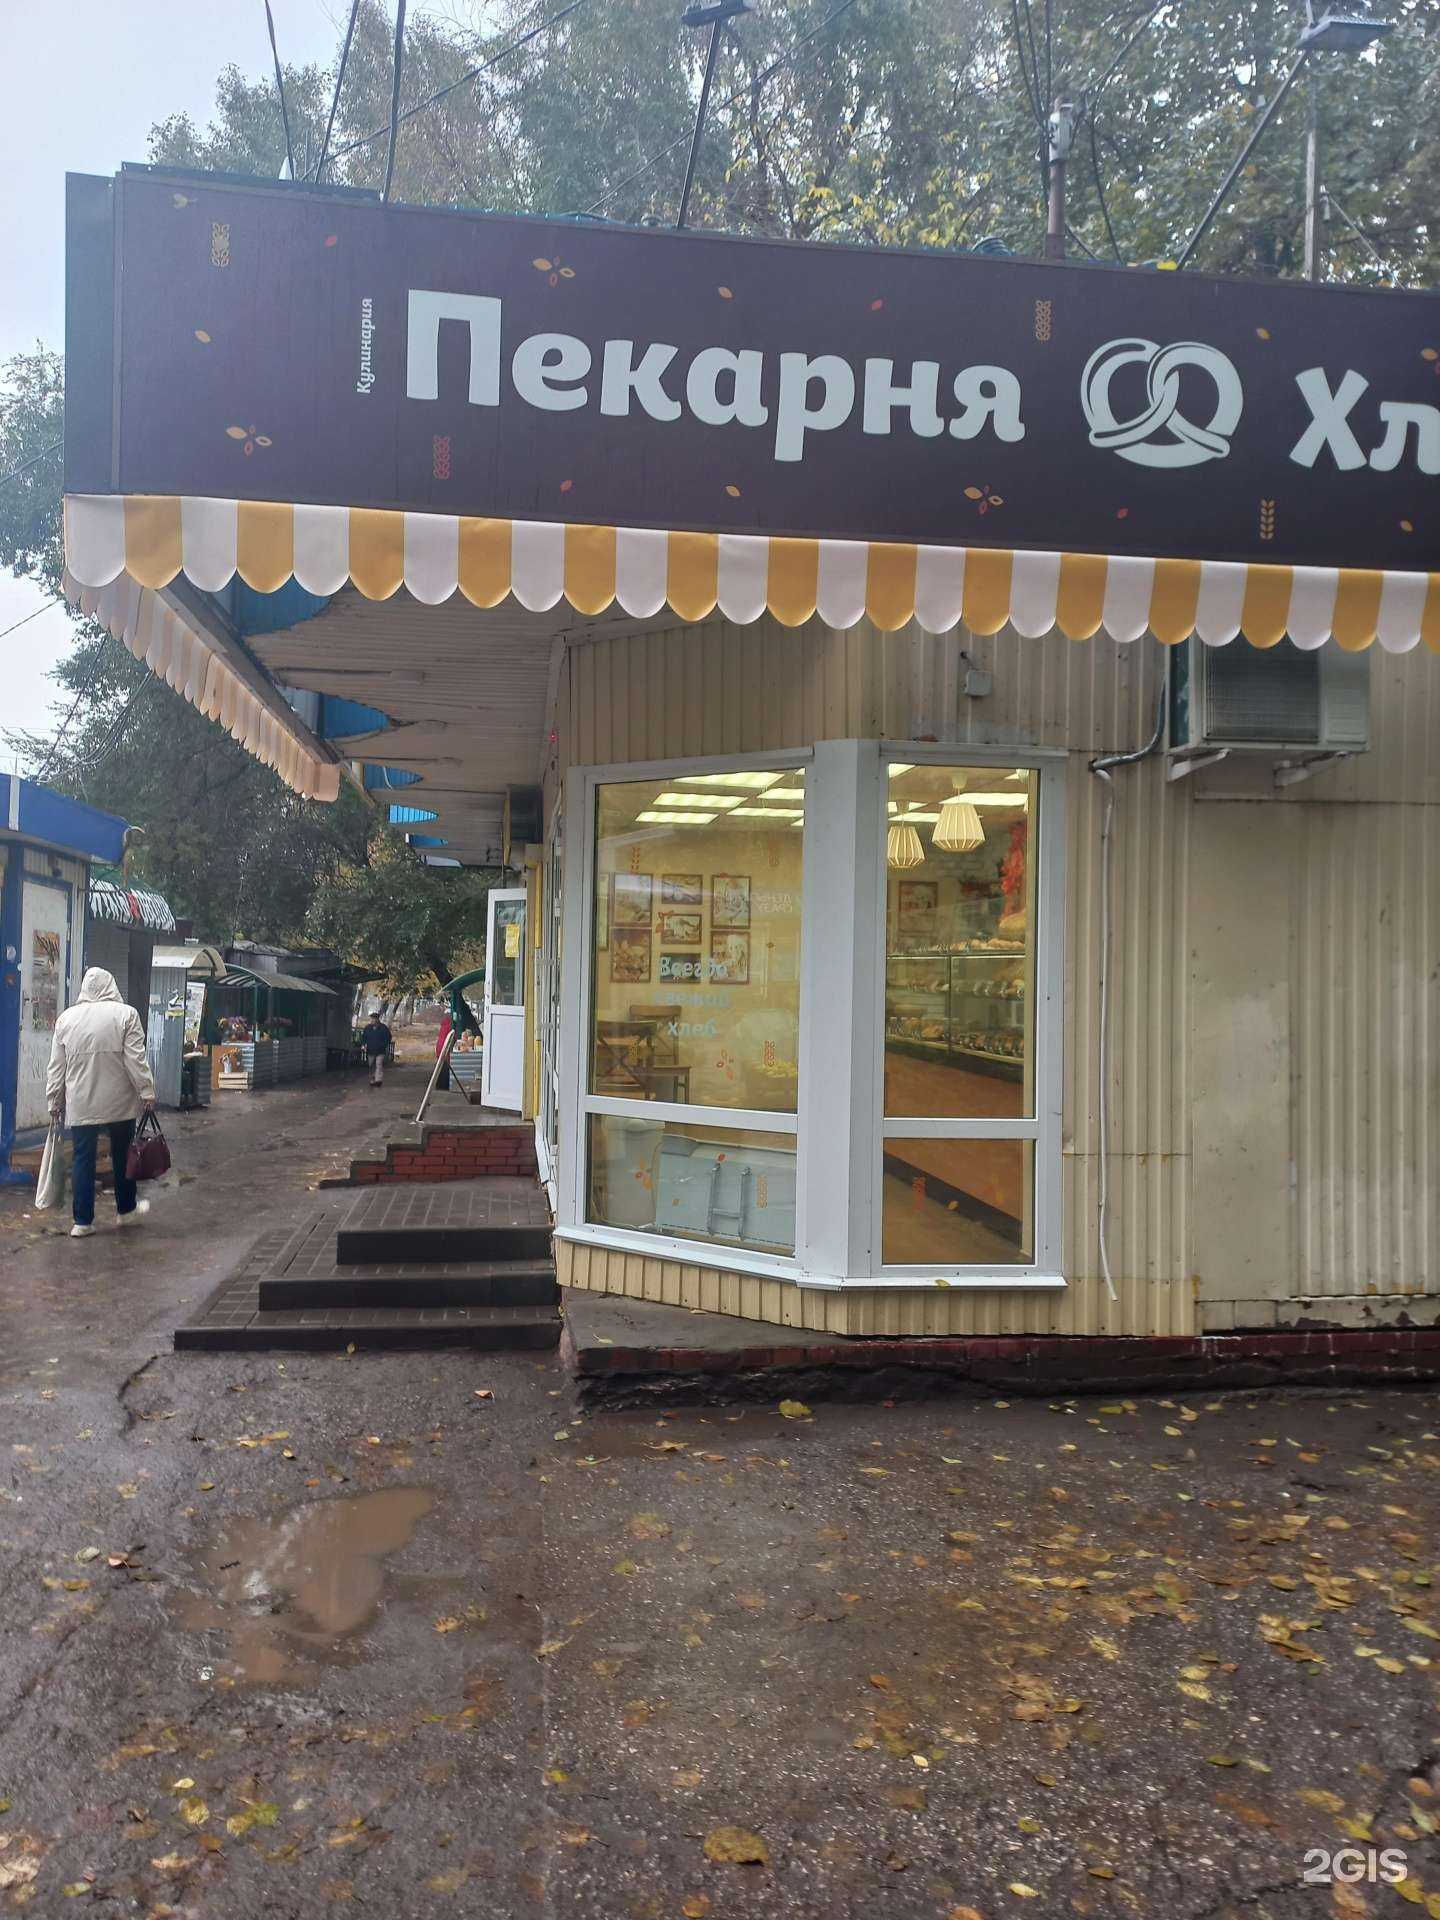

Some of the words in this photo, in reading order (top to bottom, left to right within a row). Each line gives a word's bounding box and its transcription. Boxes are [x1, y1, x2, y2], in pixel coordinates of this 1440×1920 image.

[356, 297, 375, 394] Кулинария
[406, 288, 1027, 463] Пекарня
[1288, 366, 1440, 476] Хл
[667, 1018, 718, 1038] хлеб
